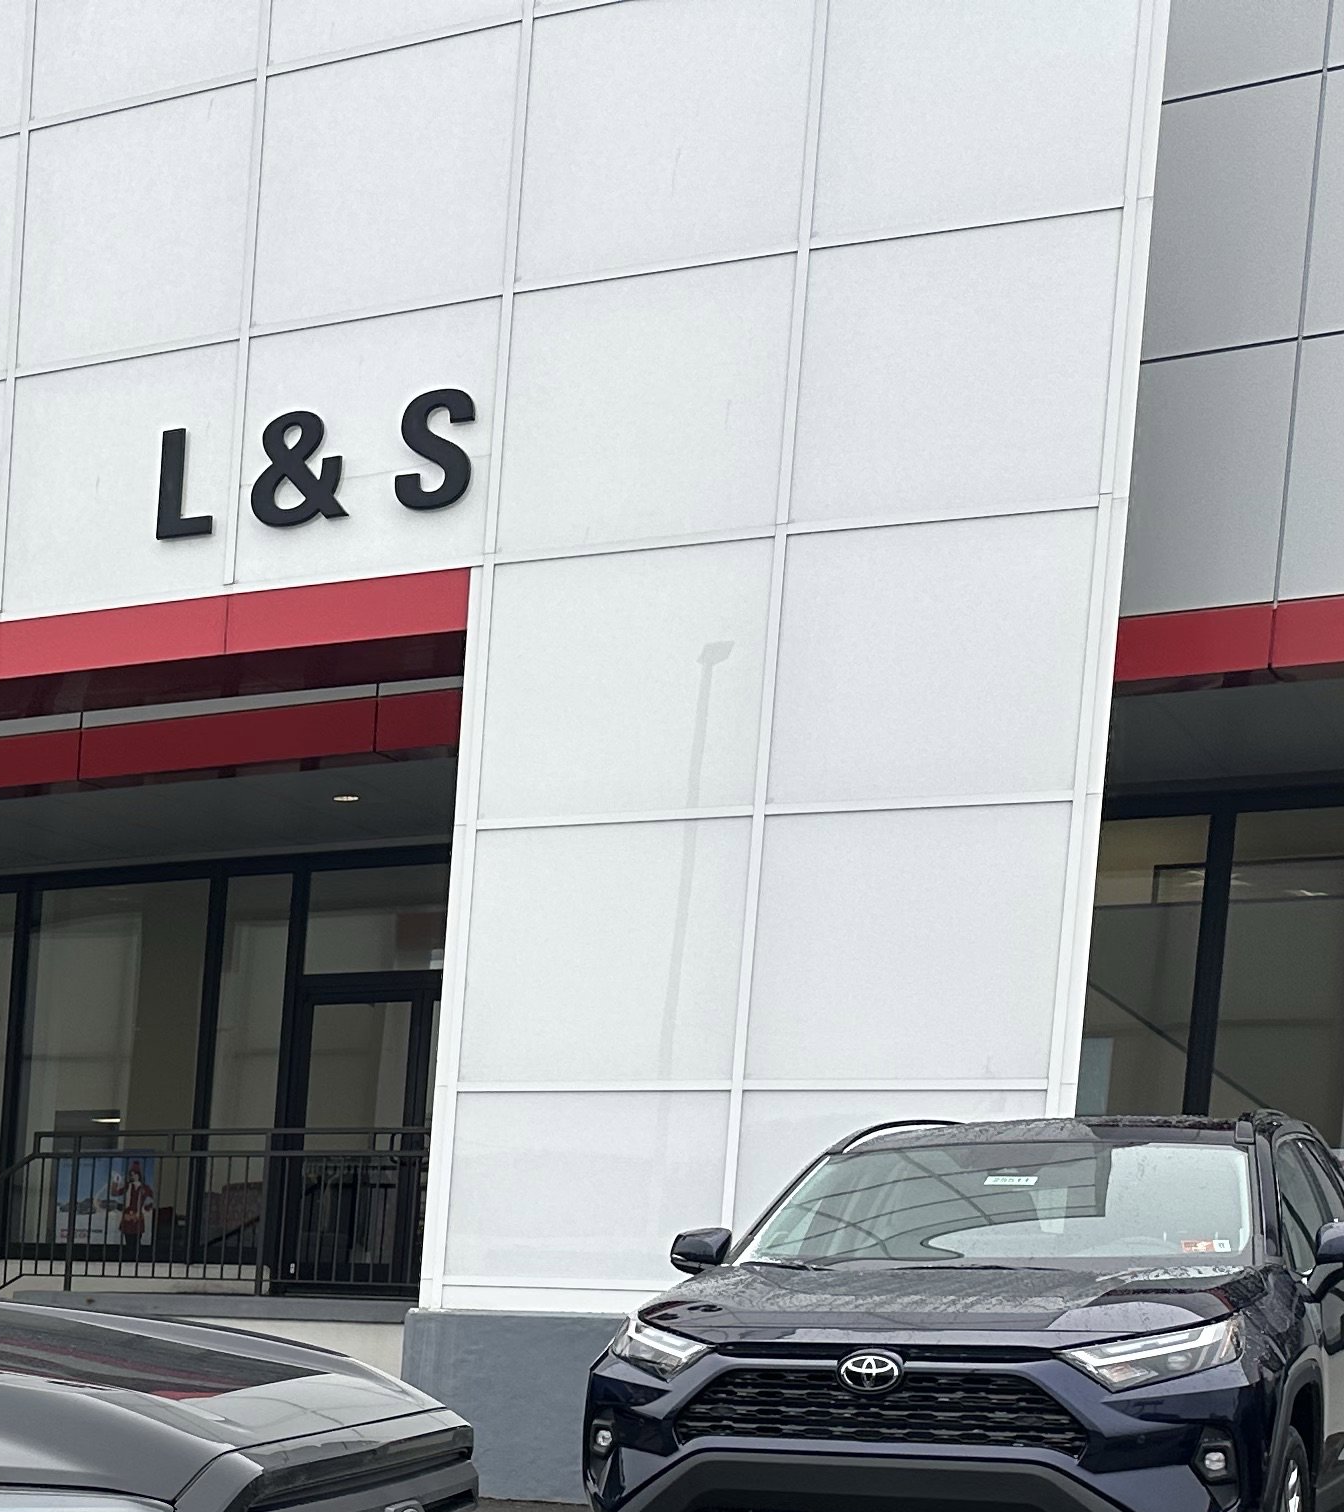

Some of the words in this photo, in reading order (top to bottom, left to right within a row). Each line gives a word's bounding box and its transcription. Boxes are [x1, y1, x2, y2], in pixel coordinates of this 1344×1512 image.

[155, 427, 213, 540] L
[250, 410, 350, 528] &
[394, 388, 476, 511] S
